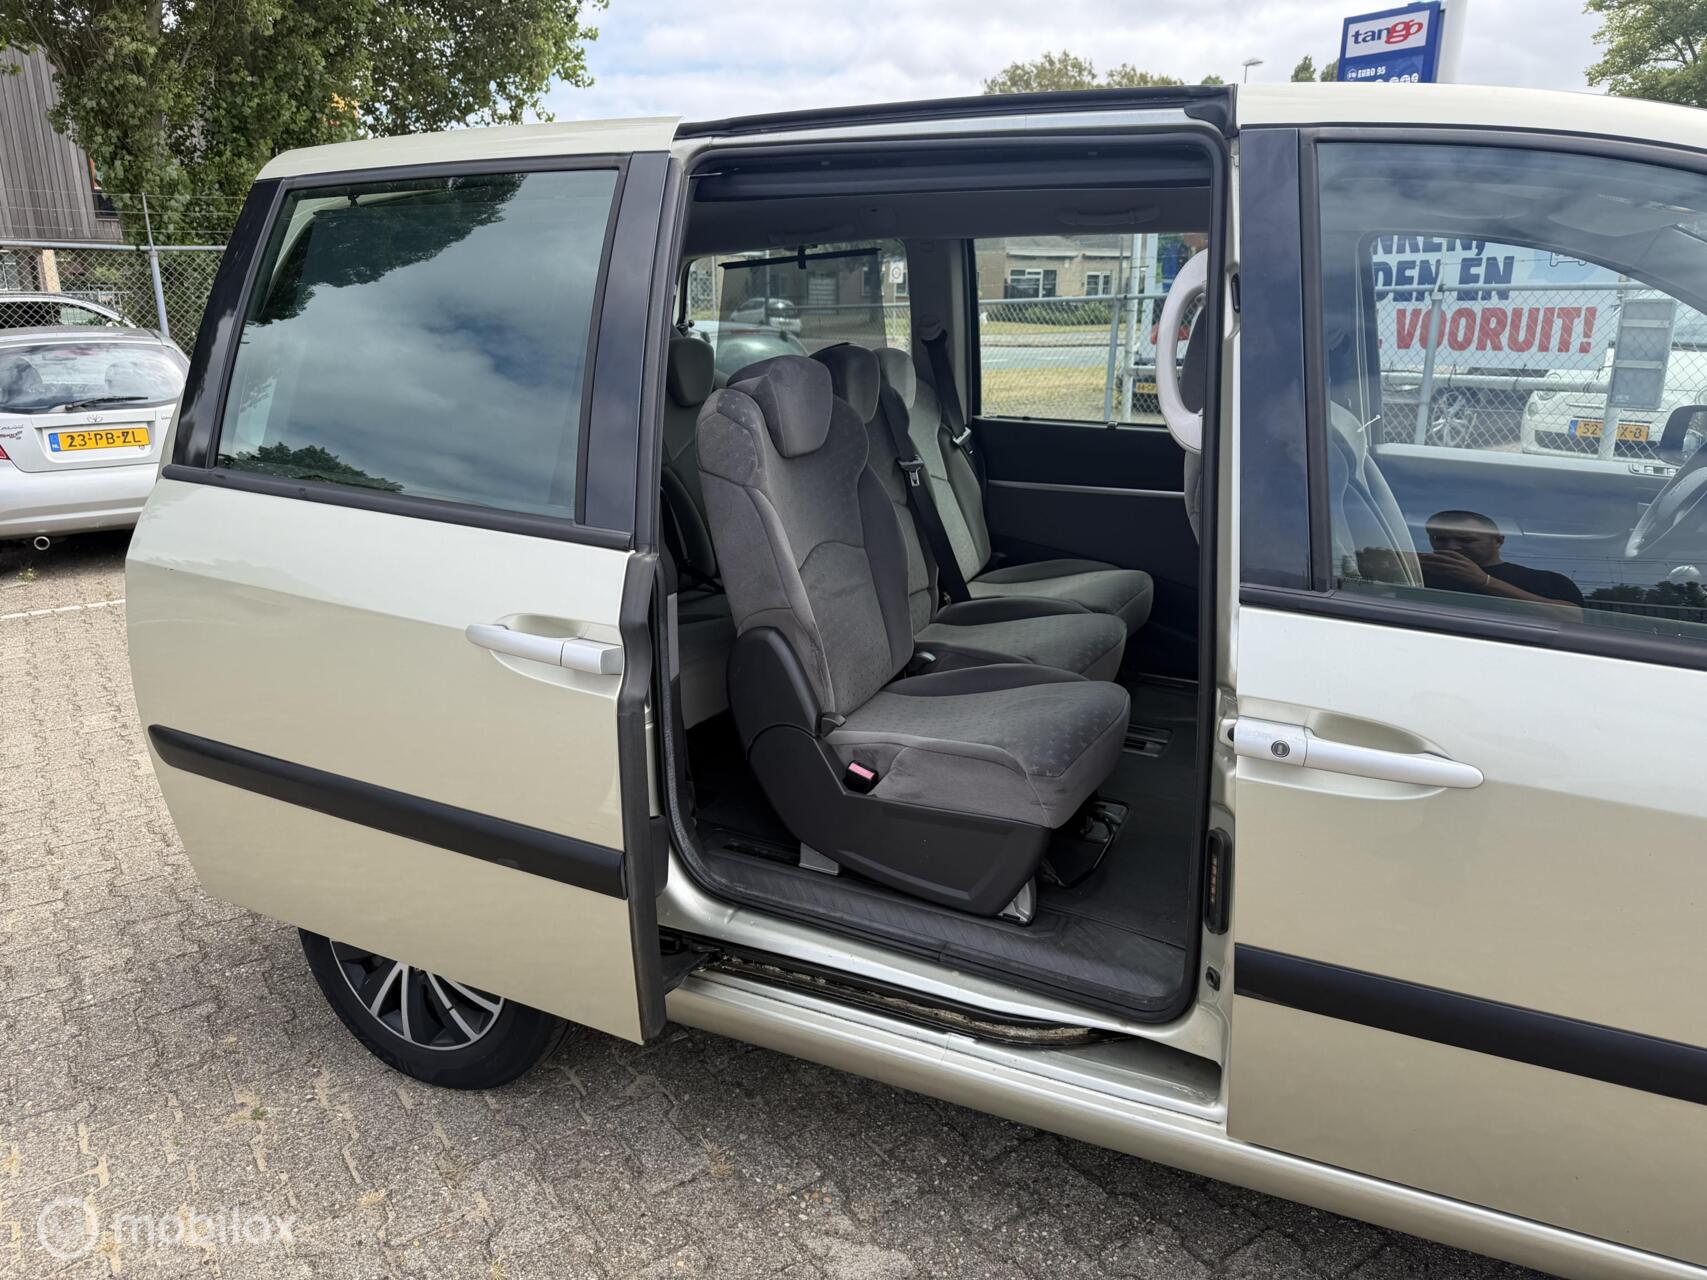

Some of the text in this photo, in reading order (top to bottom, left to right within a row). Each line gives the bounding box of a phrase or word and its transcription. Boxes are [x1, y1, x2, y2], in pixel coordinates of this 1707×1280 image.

[1352, 19, 1423, 44] tango
[1456, 256, 1515, 302] EN
[1396, 307, 1598, 353] VOORUIT!
[67, 430, 142, 448] 23-PB-ZL
